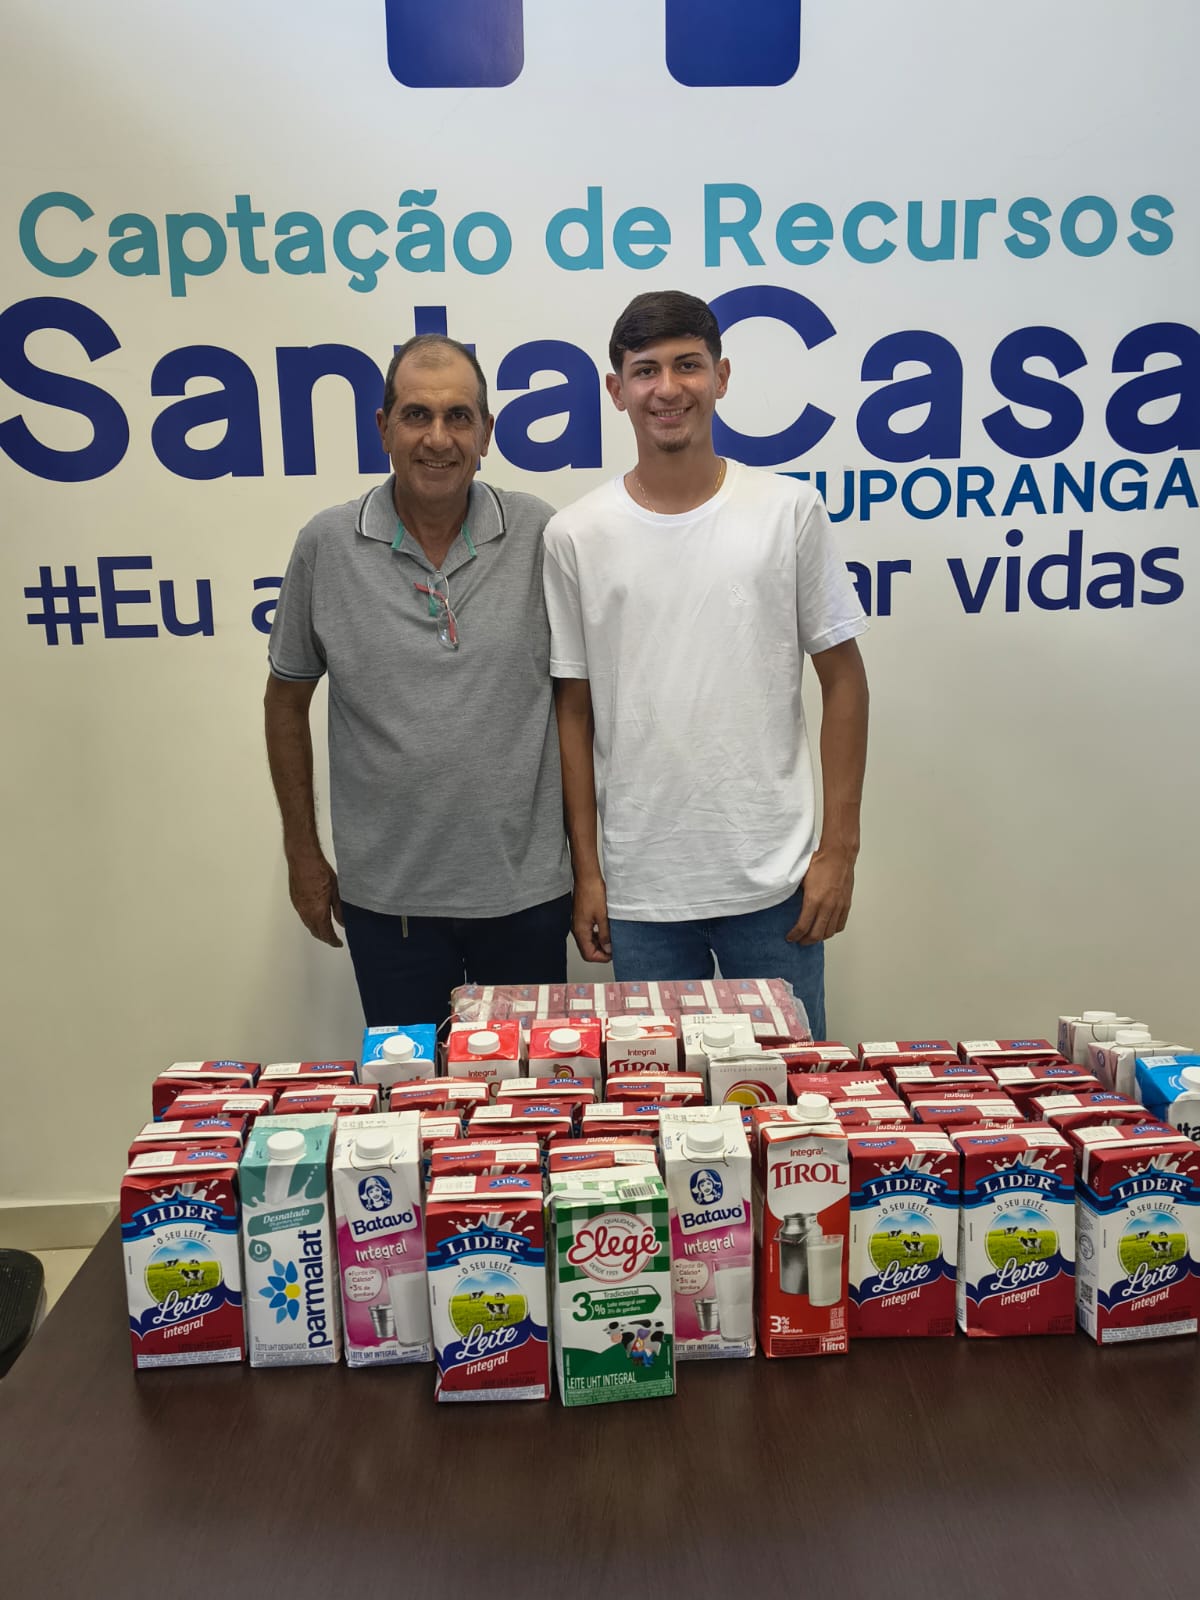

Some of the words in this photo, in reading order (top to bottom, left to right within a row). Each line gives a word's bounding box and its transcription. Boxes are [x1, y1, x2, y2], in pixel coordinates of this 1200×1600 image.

[19, 189, 512, 297] Captação
[545, 186, 672, 270] de
[703, 183, 1175, 268] Recursos
[707, 285, 1200, 466] Casa
[775, 457, 1199, 523] UPORANGA
[24, 555, 214, 645] #Eu
[946, 529, 1184, 614] vidas
[627, 1048, 657, 1057] Integral
[468, 1068, 497, 1078] Integral
[769, 1160, 848, 1190] TIROL
[984, 1174, 1052, 1194] LIDER
[869, 1178, 937, 1197] LIDER
[1118, 1178, 1183, 1199] LIDER
[882, 1207, 888, 1215] O
[890, 1202, 905, 1212] SEU
[907, 1202, 929, 1213] LEITE
[1004, 1198, 1020, 1209] SEU
[1022, 1198, 1044, 1210] LEITE
[1137, 1202, 1152, 1213] SEU
[1154, 1202, 1175, 1213] LEITE
[141, 1205, 215, 1227] LIDER
[263, 1207, 310, 1225] Desnatado
[351, 1211, 413, 1236] Batavo
[681, 1207, 742, 1228] Batavo
[165, 1230, 181, 1241] SEU
[184, 1230, 207, 1240] LEITE
[446, 1236, 520, 1256] LIDER
[683, 1232, 735, 1256] Integral
[355, 1238, 408, 1263] Integral
[568, 1226, 661, 1273] Elegê
[461, 1267, 468, 1275] O
[470, 1261, 486, 1271] SEU
[489, 1261, 513, 1273] LEITE
[871, 1260, 931, 1293] Leite
[990, 1257, 1049, 1291] Leite
[1121, 1262, 1178, 1297] Leite
[298, 1229, 333, 1349] parmalat
[603, 1288, 639, 1298] Tradicional
[881, 1287, 920, 1308] integral
[1000, 1284, 1041, 1306] integral
[1130, 1287, 1170, 1311] integral
[152, 1290, 214, 1325] Leite
[163, 1316, 204, 1340] integral
[455, 1323, 518, 1360] Leite
[466, 1352, 509, 1376] integral
[566, 1377, 585, 1390] LEITE
[586, 1375, 602, 1388] UHT
[602, 1371, 637, 1386] INTEGRAL
